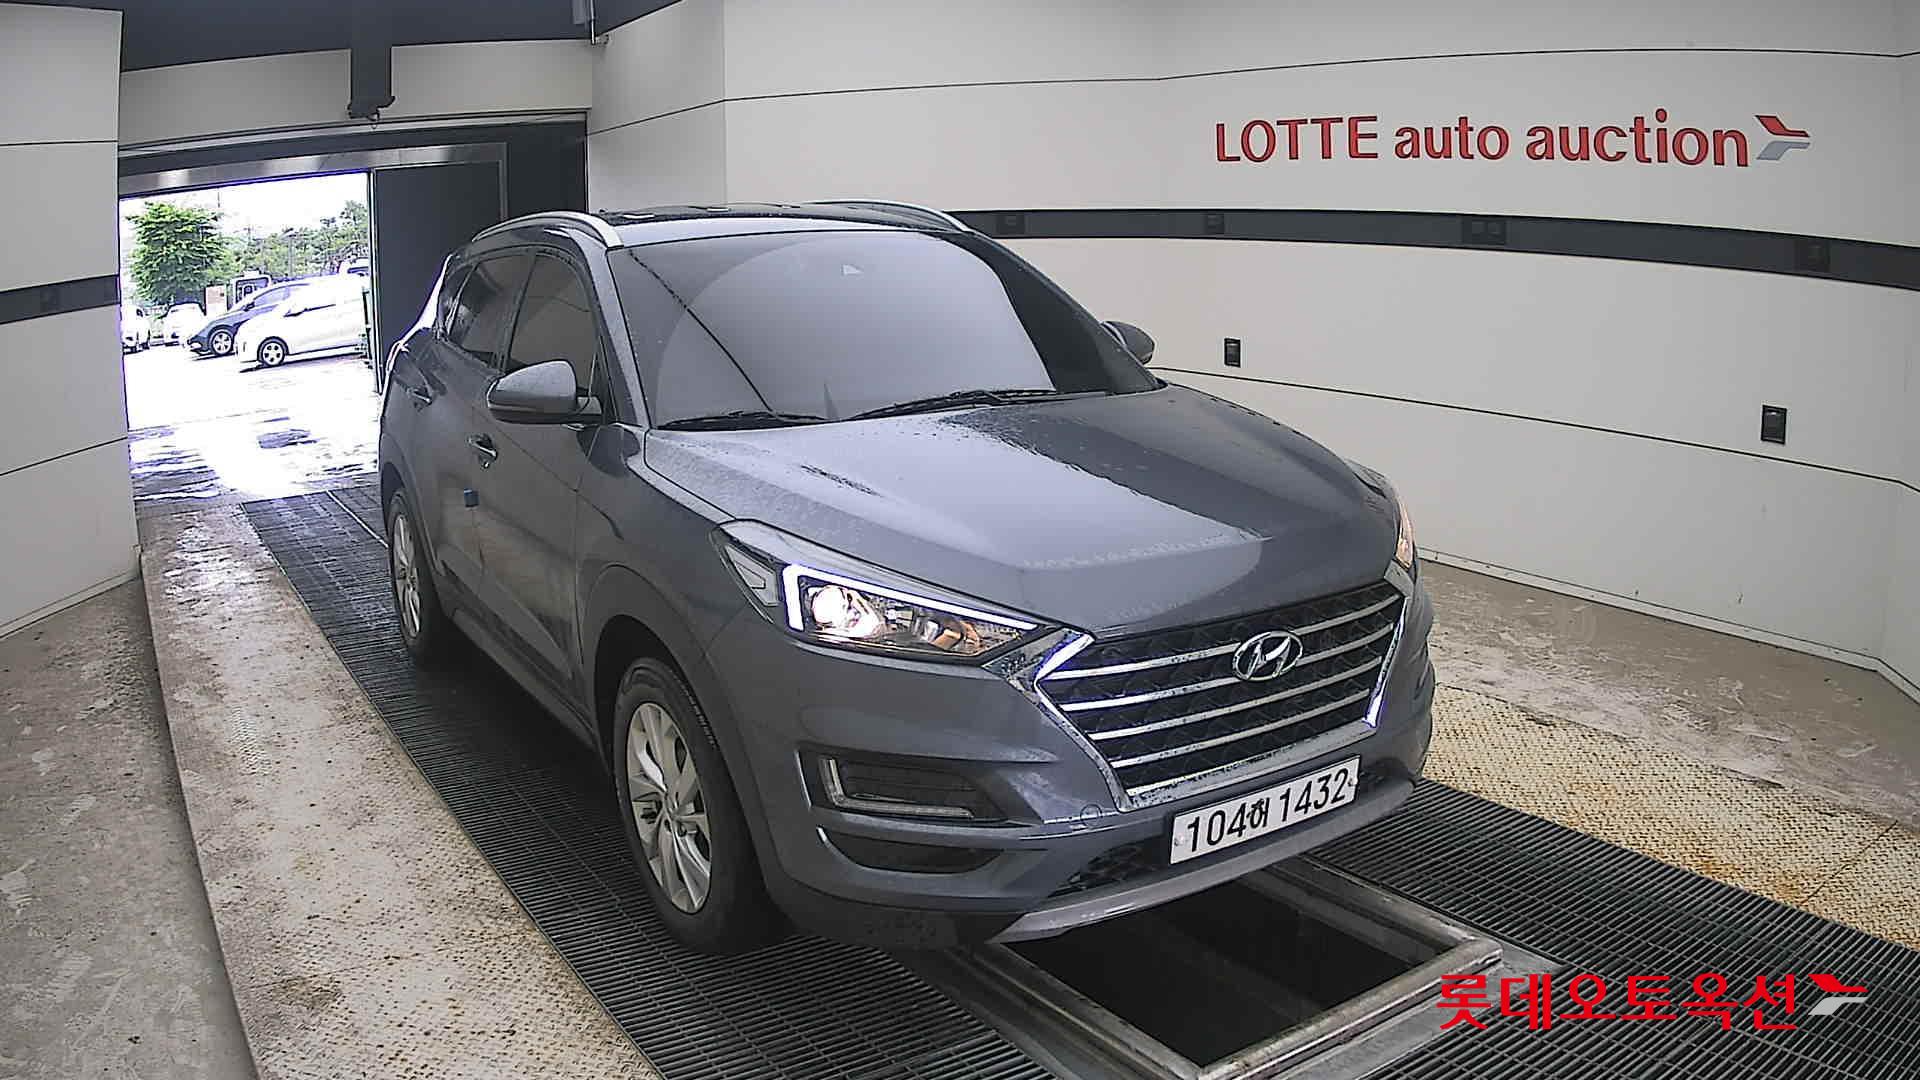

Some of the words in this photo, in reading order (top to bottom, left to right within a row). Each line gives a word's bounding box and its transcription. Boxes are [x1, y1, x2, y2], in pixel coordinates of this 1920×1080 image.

[1215, 115, 1379, 162] LOTTE
[1393, 115, 1511, 161] auto
[1525, 108, 1750, 167] auction
[1187, 797, 1271, 852] 104허
[1279, 767, 1350, 823] 1432
